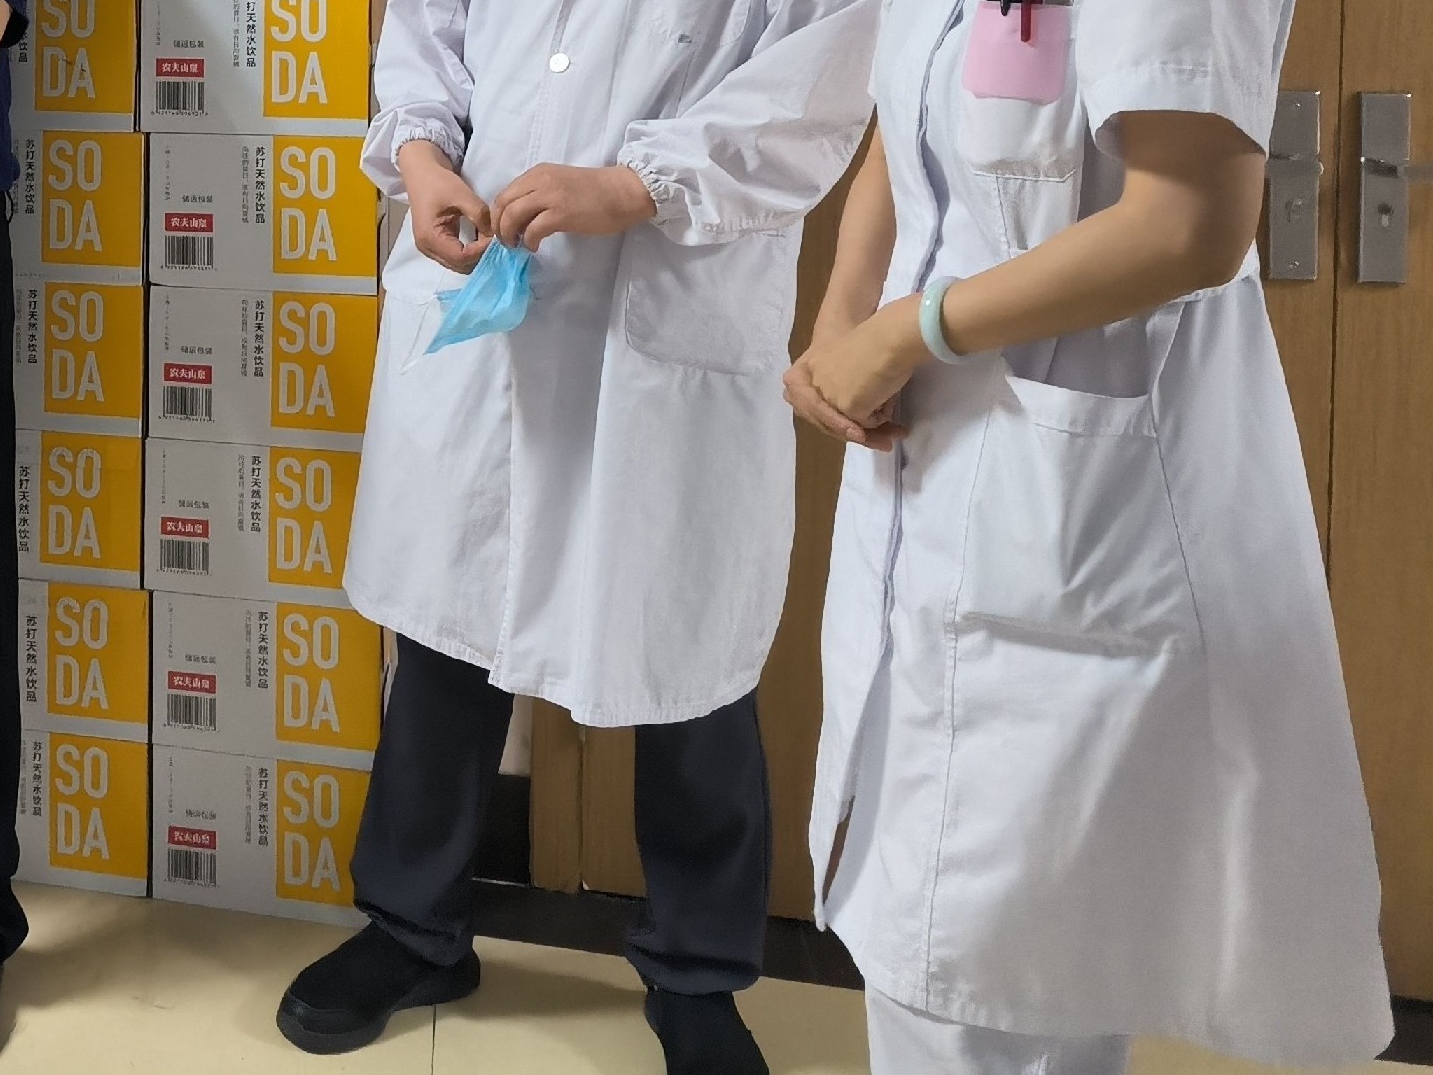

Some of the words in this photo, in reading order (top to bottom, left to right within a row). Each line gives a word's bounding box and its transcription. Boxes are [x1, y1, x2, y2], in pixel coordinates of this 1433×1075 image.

[42, 48, 96, 99] DA
[272, 51, 327, 104] DA
[24, 139, 35, 214] 苏打天然水饮品
[47, 139, 103, 192] SO
[255, 147, 265, 223] 苏打天然水饮品
[280, 146, 335, 199] SO
[49, 198, 103, 252] DA
[281, 208, 336, 261] DA
[28, 290, 38, 364] 苏打天然水饮品
[51, 290, 104, 343] SO
[254, 300, 264, 377] 苏打天然水饮品
[279, 301, 335, 356] SO
[51, 349, 105, 402] DA
[279, 362, 334, 417] DA
[48, 447, 101, 499] SO
[251, 456, 261, 532] 苏打天然水饮品
[275, 457, 331, 511] SO
[18, 466, 30, 553] 苏打天然水饮品
[48, 505, 101, 559] DA
[276, 518, 331, 574] DA
[54, 597, 108, 650] SO
[257, 612, 268, 689] 苏打天然水饮品
[283, 613, 339, 669] SO
[25, 616, 38, 702] 苏打天然水饮品
[55, 655, 109, 710] DA
[283, 675, 339, 732] DA
[32, 741, 42, 817] 苏打天然水饮品
[55, 743, 108, 799] SO
[283, 772, 339, 828] SO
[57, 803, 109, 860] DA
[284, 831, 340, 891] DA
